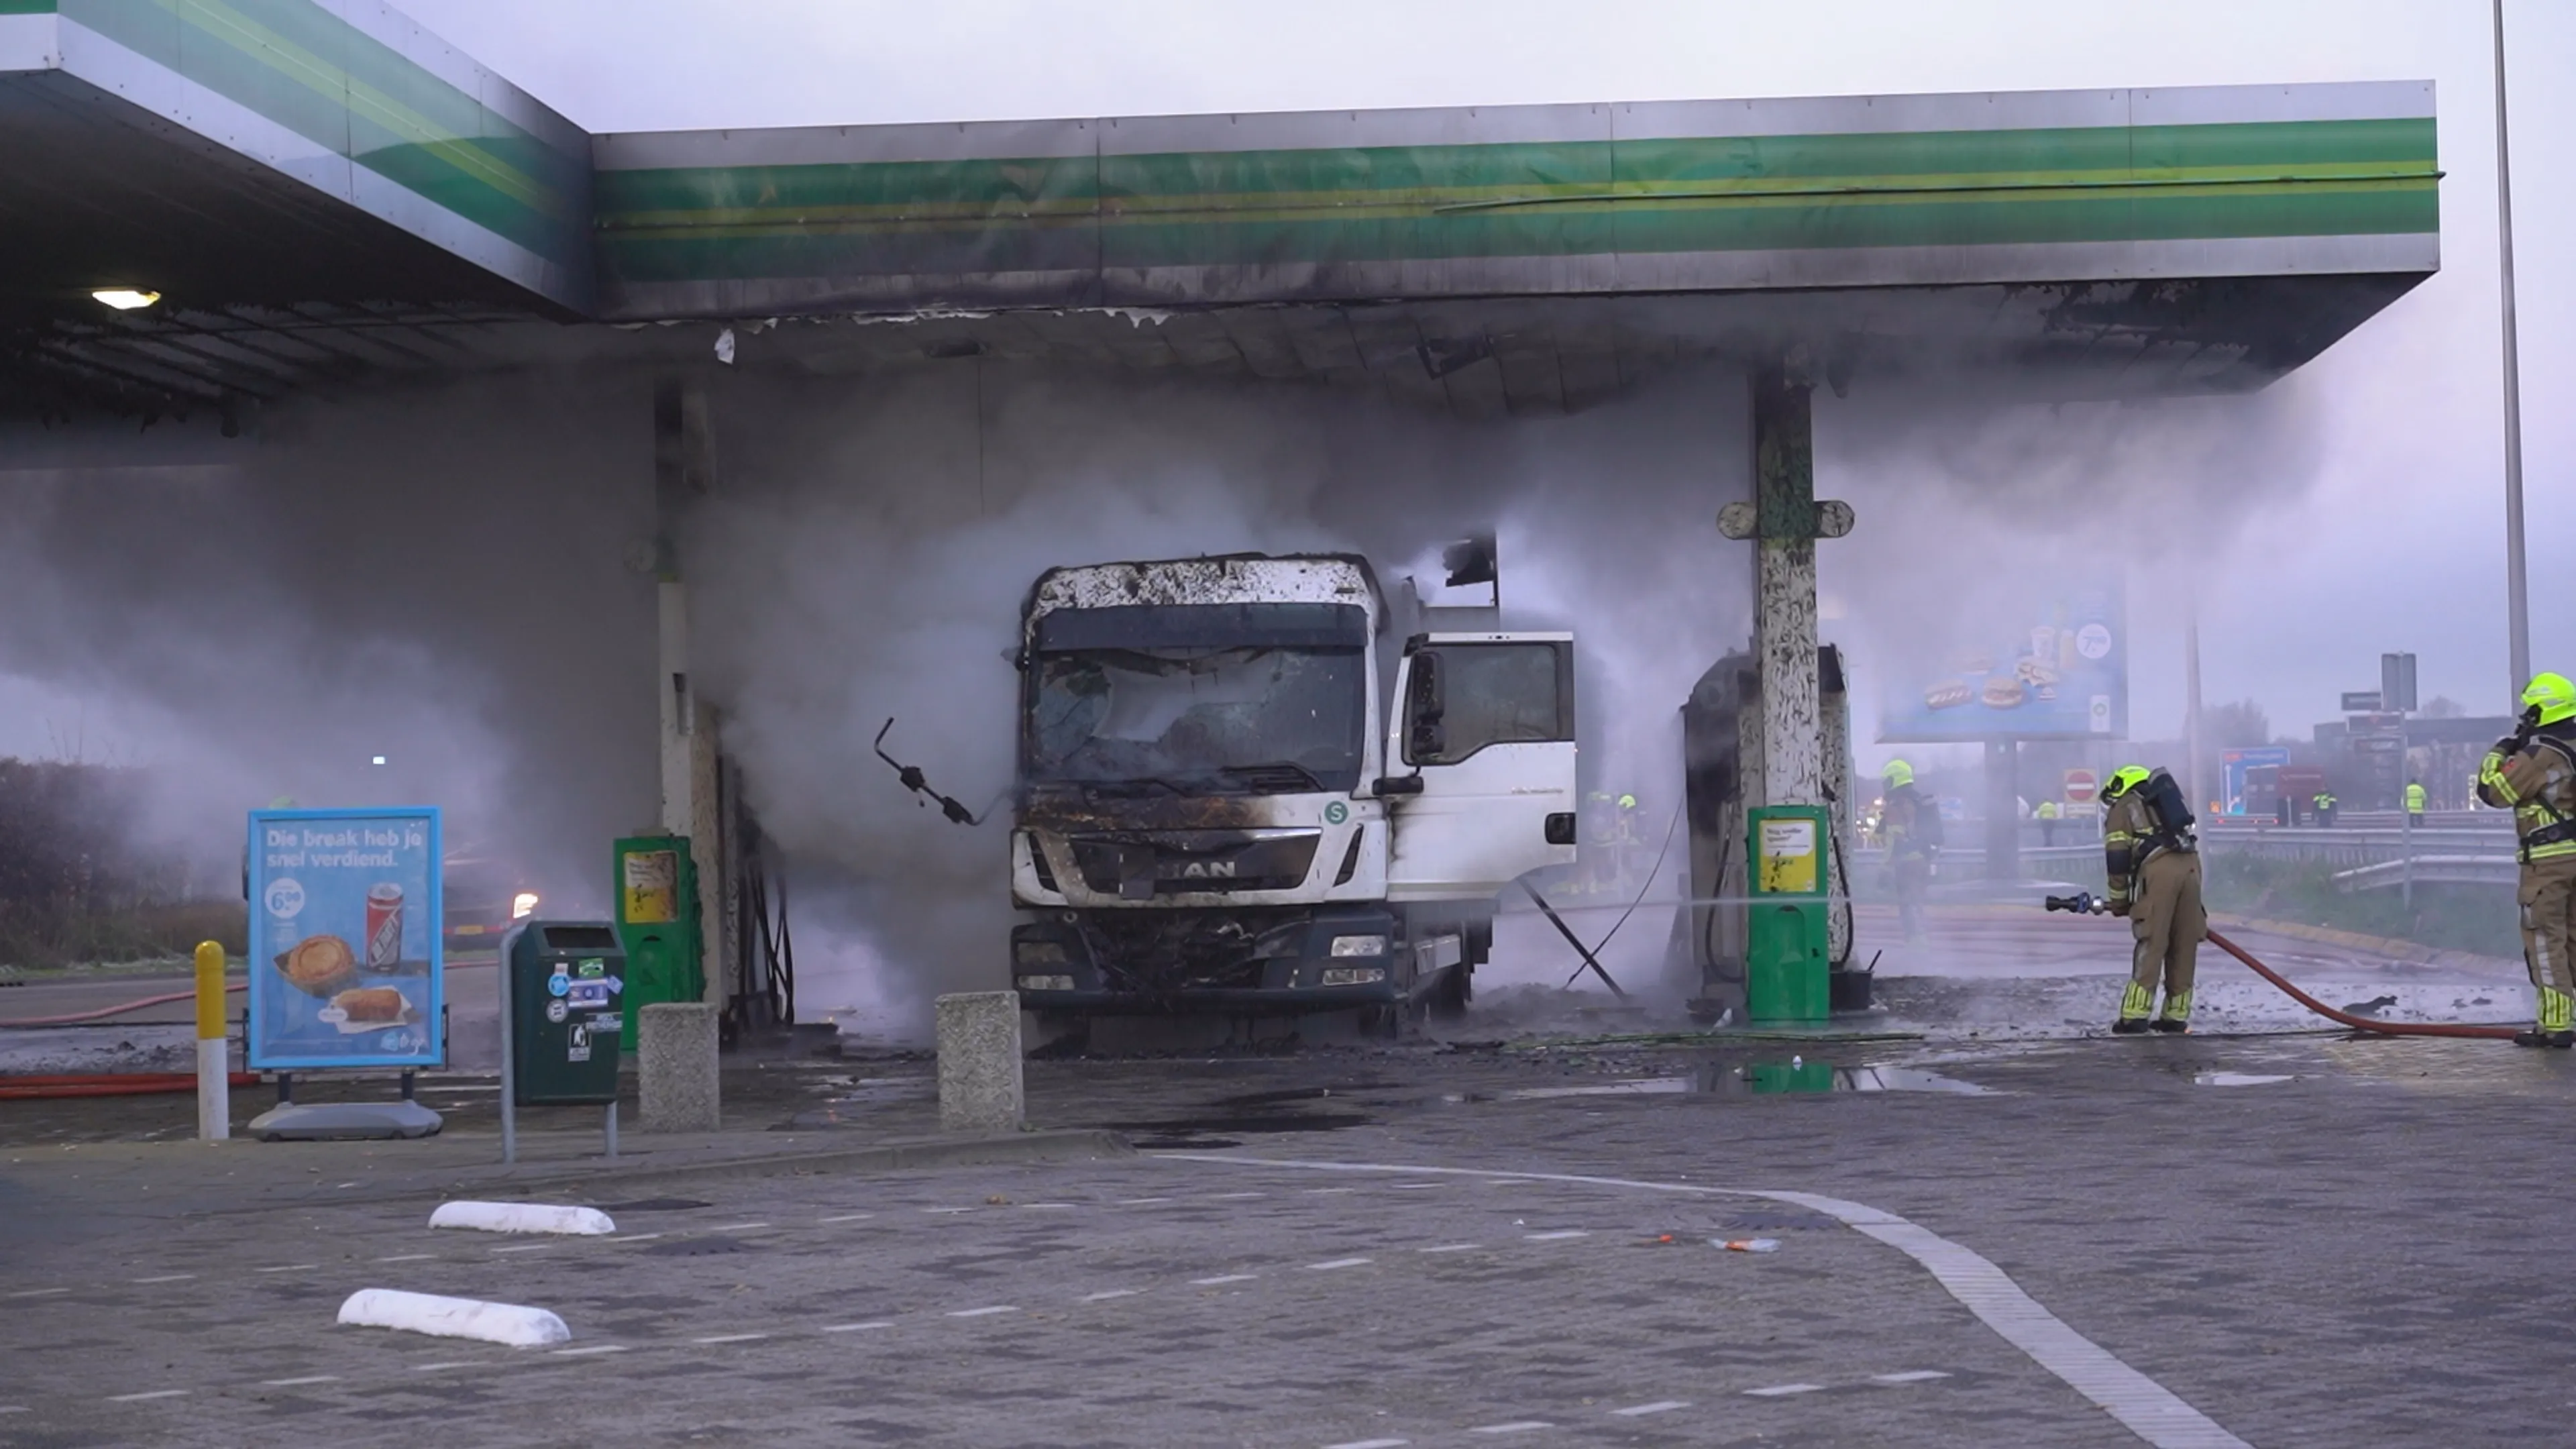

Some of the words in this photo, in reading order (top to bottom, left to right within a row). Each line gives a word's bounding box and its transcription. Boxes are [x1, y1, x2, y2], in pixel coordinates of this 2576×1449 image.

[1330, 804, 1343, 821] S
[268, 830, 298, 847] Die
[303, 828, 358, 847] break
[364, 828, 400, 847] heb
[402, 828, 422, 850] je
[268, 851, 305, 867] snel
[310, 849, 398, 867] verdiend.
